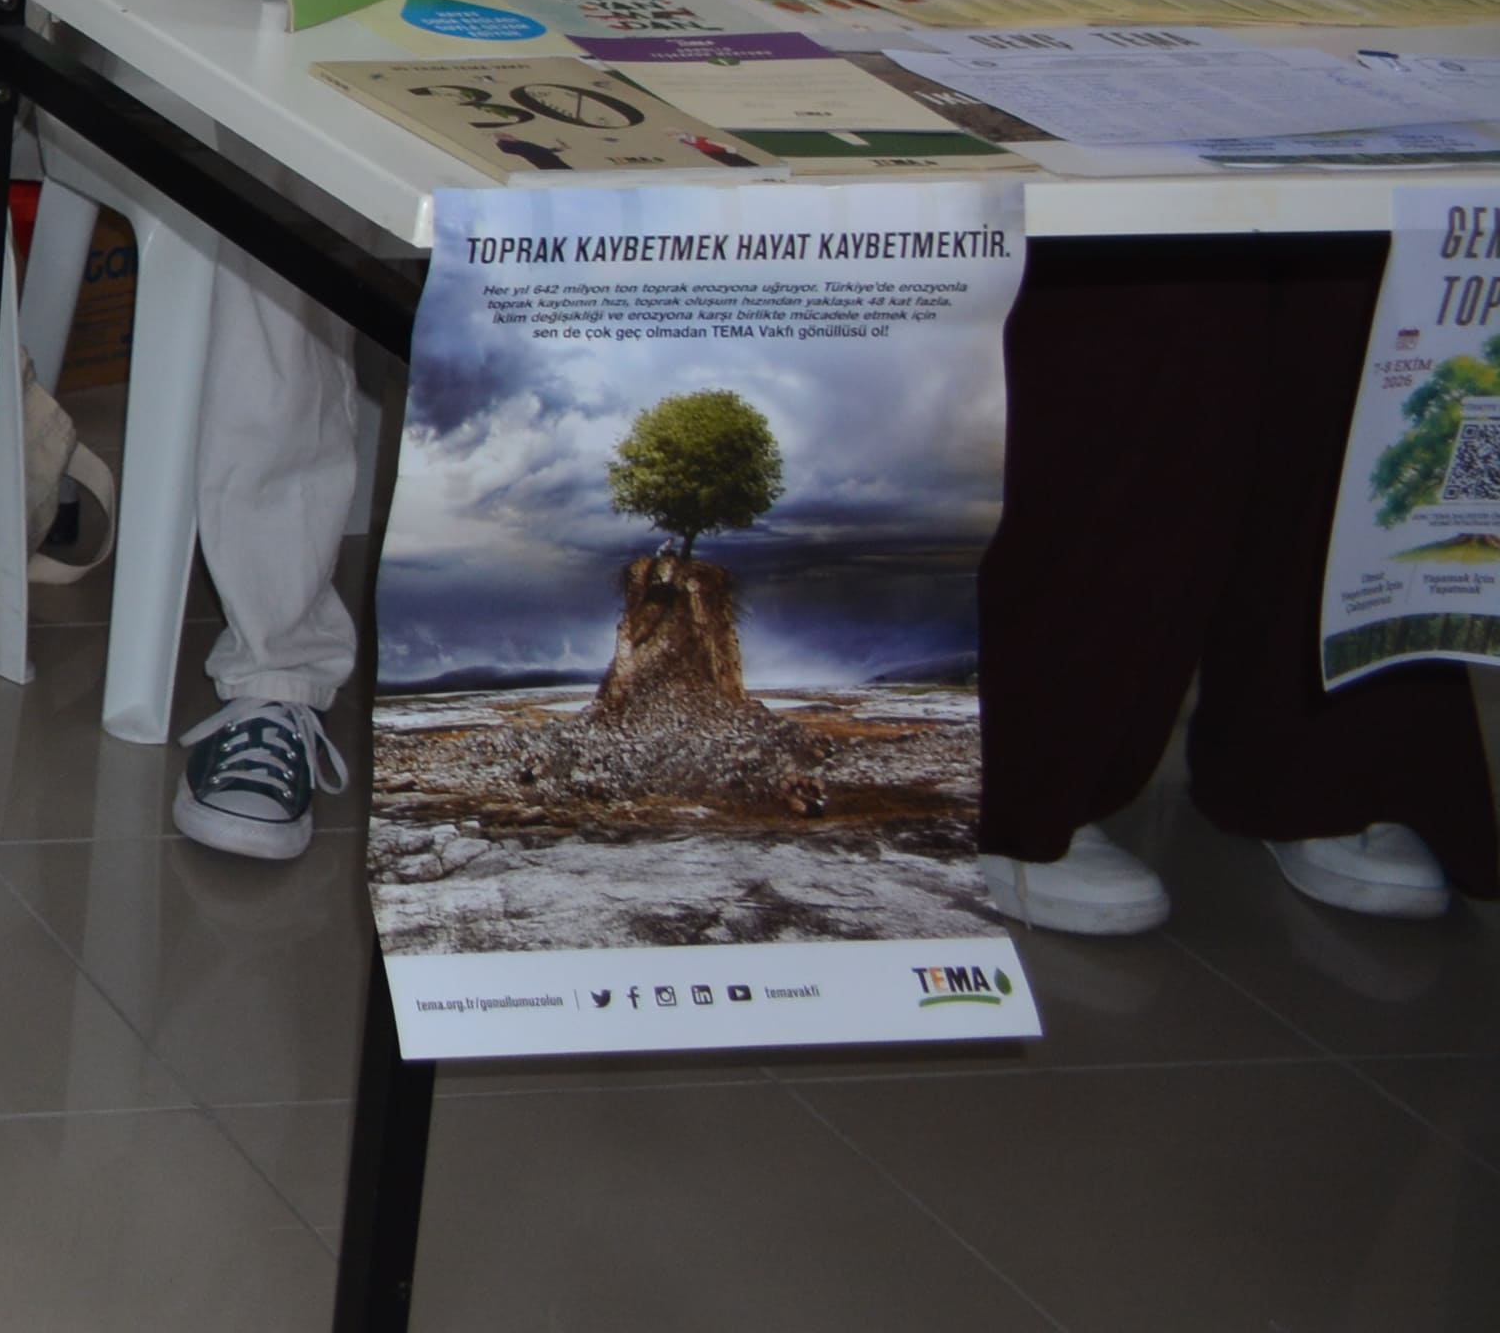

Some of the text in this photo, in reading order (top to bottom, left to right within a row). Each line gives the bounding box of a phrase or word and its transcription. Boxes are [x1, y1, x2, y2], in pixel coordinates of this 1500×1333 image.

[465, 224, 1012, 264] TOPRAK KAYBETMEK HAYAT KAYBETMEKTİR.
[483, 280, 969, 298] Her yıl 642 milyon ton toprak erozyona uğruyor. Türkiye'de erozyonla
[486, 298, 533, 311] toprak
[536, 297, 597, 310] kaybının
[634, 295, 681, 309] toprak
[684, 296, 738, 309] oluşum
[741, 295, 802, 307] hızından
[806, 295, 864, 309] yaklaşık
[867, 296, 885, 307] 48
[888, 295, 912, 307] kat
[492, 308, 938, 323] İklim değişikliği ve erozyona karşı birlikte mücadele etmek için
[531, 329, 559, 339] sen
[562, 326, 582, 339] de
[585, 325, 612, 341] çok
[615, 328, 643, 342] geç
[646, 325, 708, 338] olmadan
[711, 325, 754, 338] TEMA
[798, 325, 868, 340] gönüllüsü
[871, 324, 890, 337] ol!
[1394, 358, 1434, 374] EKİM
[912, 964, 991, 995] TEMA
